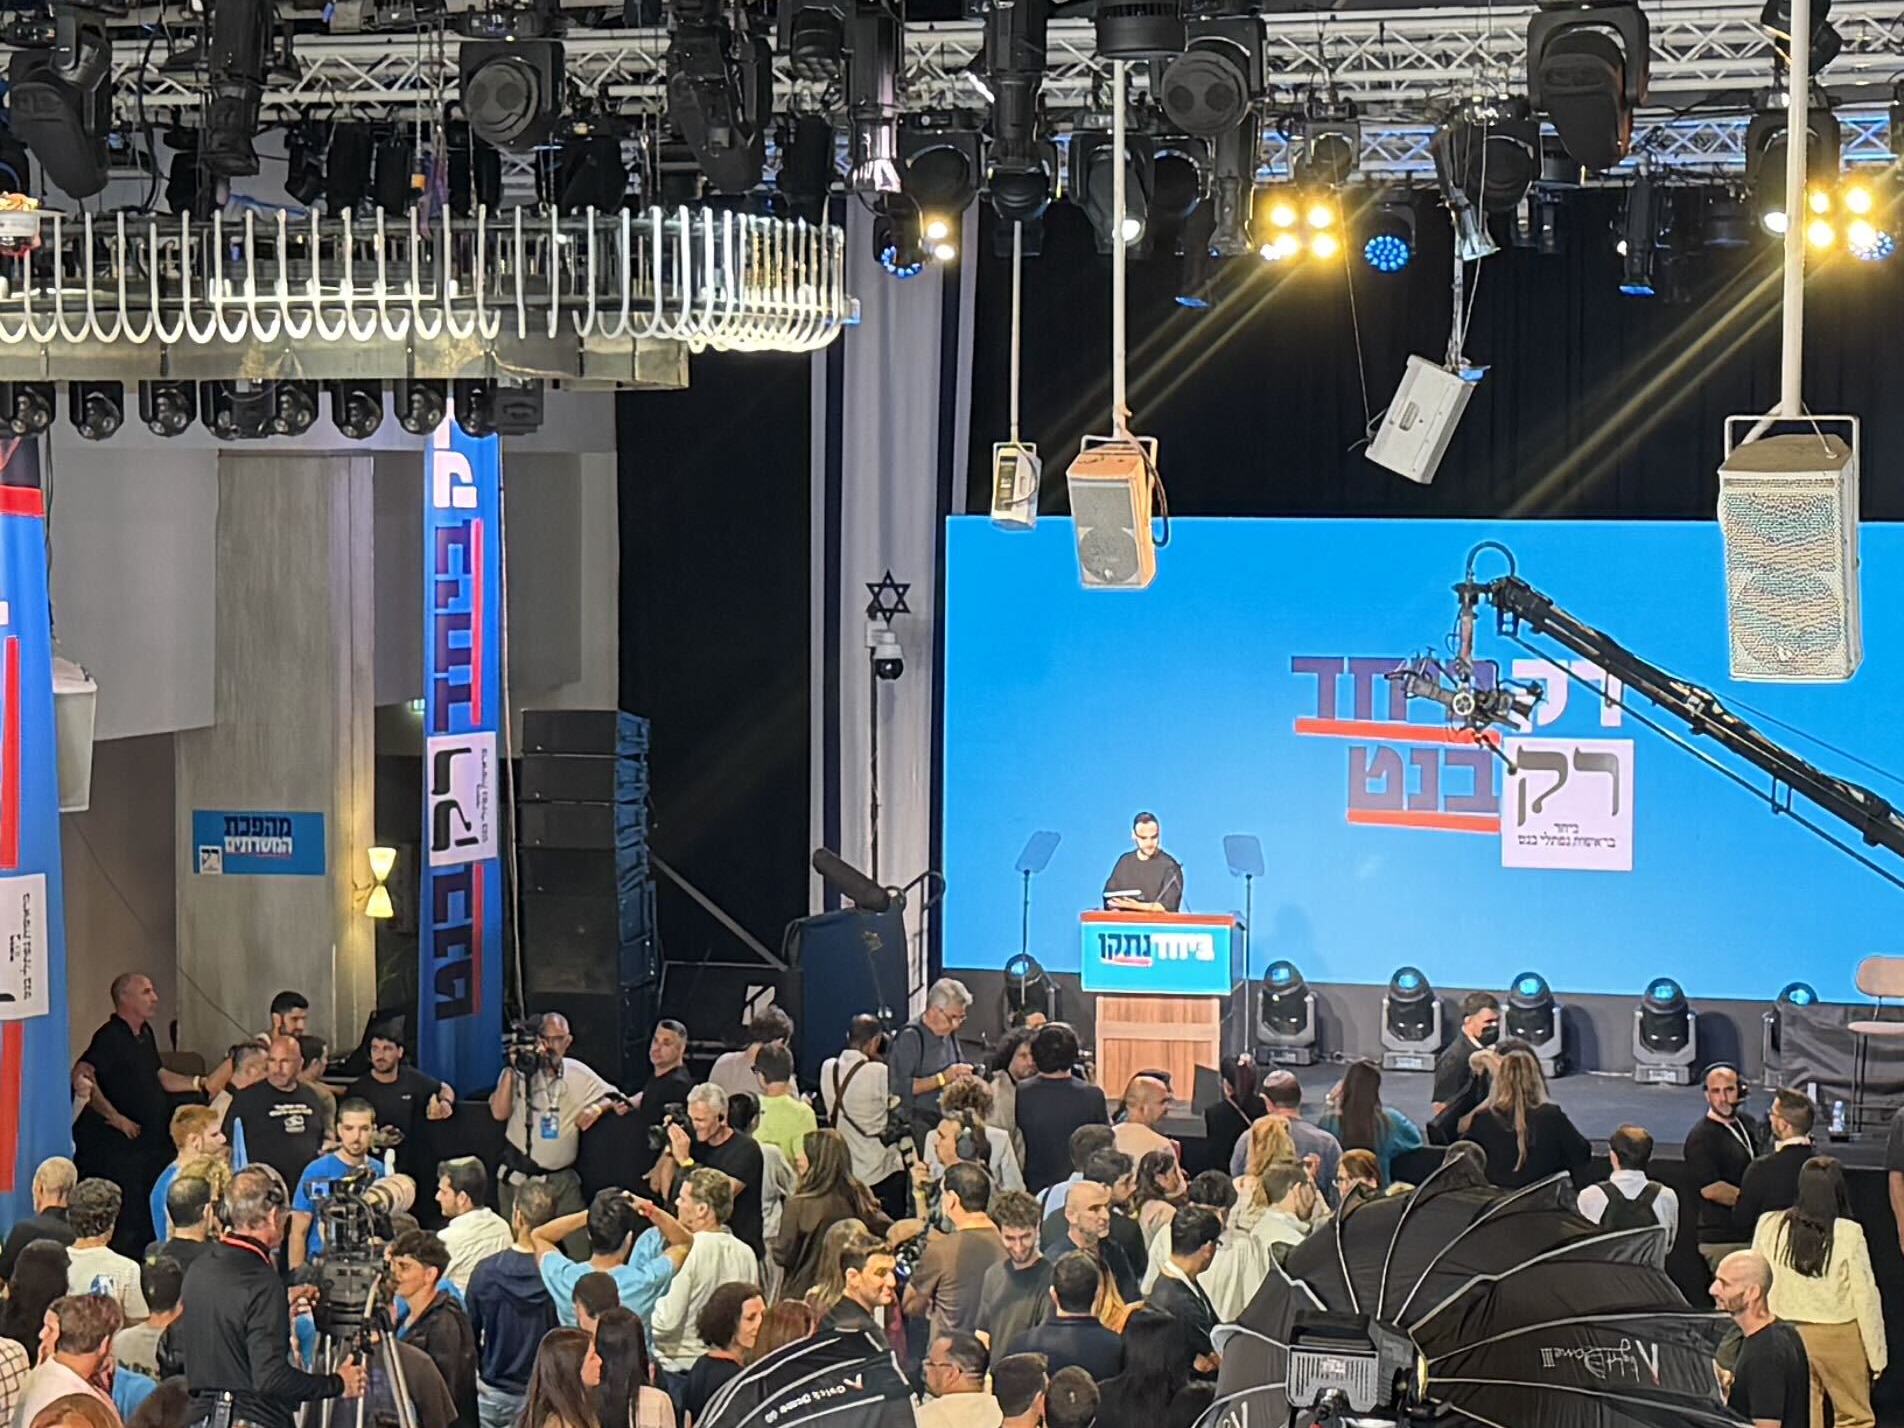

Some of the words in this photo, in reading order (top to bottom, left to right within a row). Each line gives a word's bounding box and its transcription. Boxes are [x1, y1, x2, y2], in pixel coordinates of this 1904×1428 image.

[433, 519, 473, 732] ביחד
[431, 747, 480, 851] רק
[1348, 745, 1499, 812] בנט
[1517, 745, 1620, 828] רק
[224, 816, 292, 838] מהפכת
[224, 836, 293, 855] המשרתים
[432, 871, 473, 1021] בנט
[1098, 933, 1152, 960] נתקן
[1150, 933, 1215, 961] ביחד
